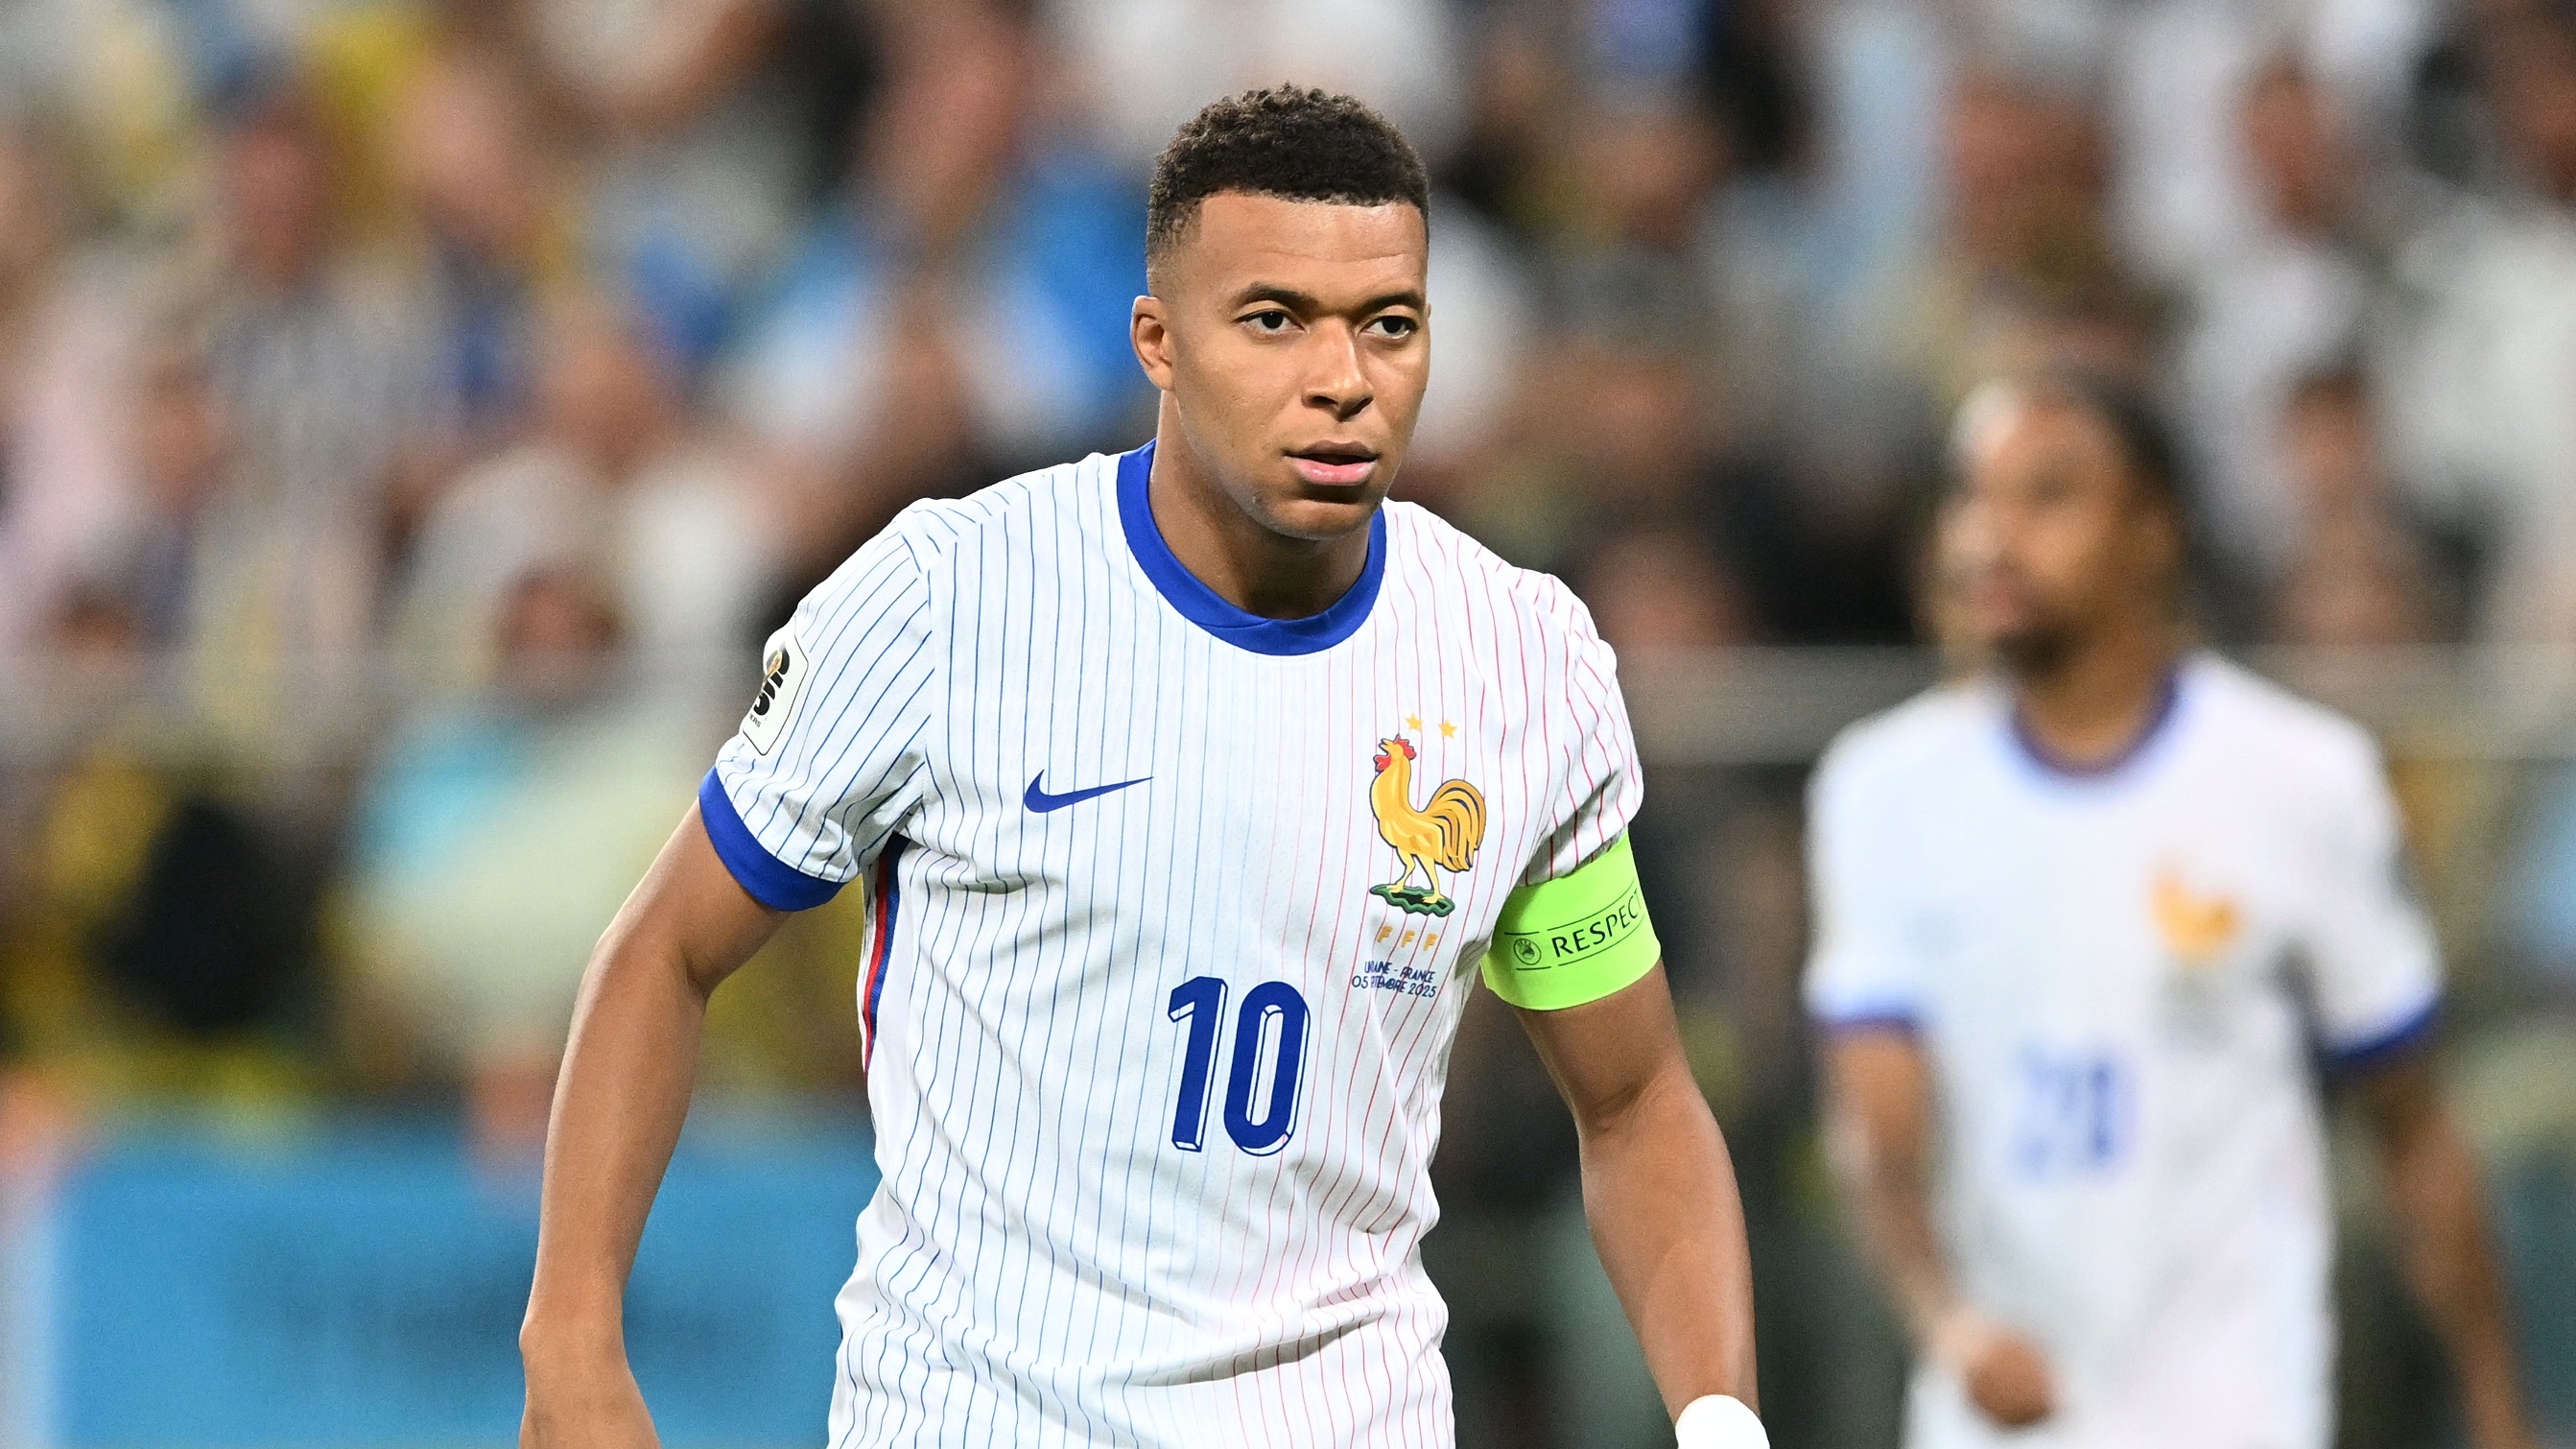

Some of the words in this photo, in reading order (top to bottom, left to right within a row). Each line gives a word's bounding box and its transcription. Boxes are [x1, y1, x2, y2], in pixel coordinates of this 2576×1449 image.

[1551, 888, 1642, 958] RESPECT
[1352, 975, 1368, 988] 05
[1407, 983, 1437, 998] 2025
[1400, 966, 1435, 983] FRANCE
[1168, 976, 1311, 1157] 10
